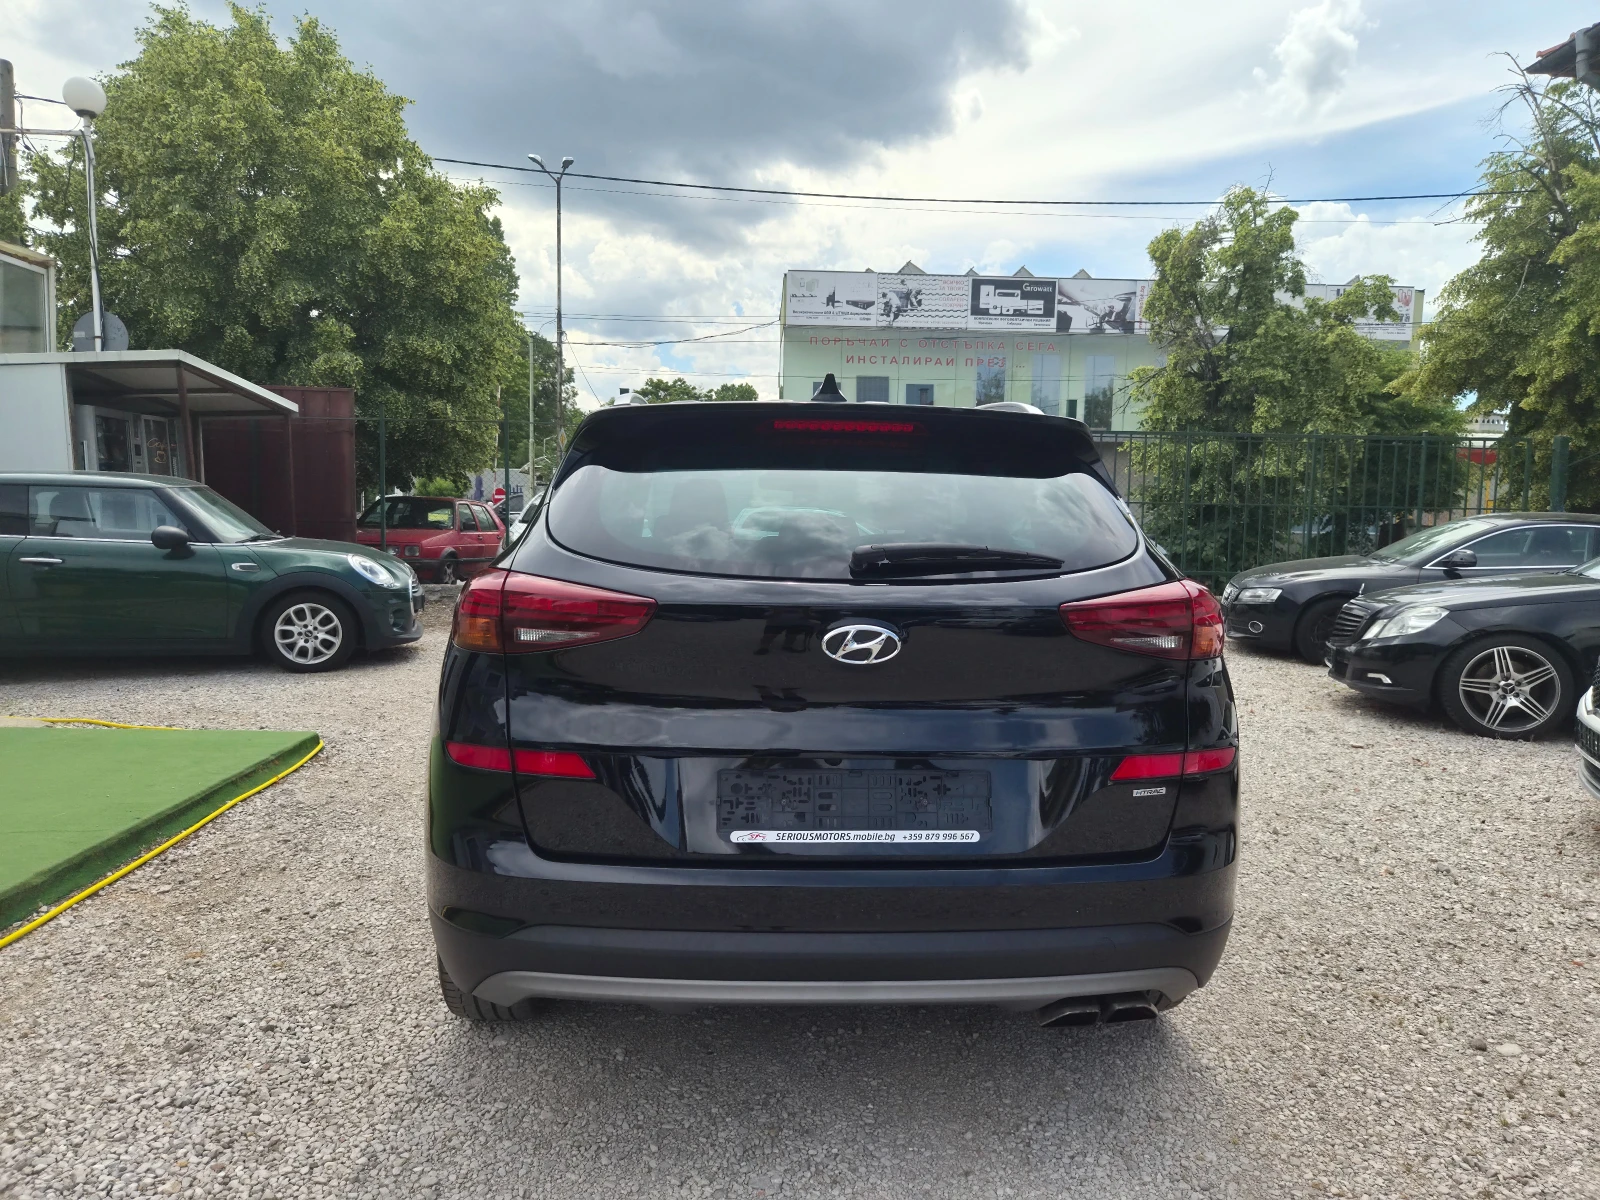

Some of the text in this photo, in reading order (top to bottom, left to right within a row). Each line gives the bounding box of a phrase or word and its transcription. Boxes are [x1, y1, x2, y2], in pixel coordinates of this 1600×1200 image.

[1022, 282, 1053, 293] Growatt
[809, 336, 889, 347] ПОРЪЧАЙ
[900, 338, 908, 348] С
[918, 339, 1005, 350] ОТСТЪПКА
[846, 355, 955, 366] ИНСТАЛИРАЙ
[965, 356, 1006, 368] ПРЕЗ
[775, 832, 896, 842] SERIOUSMOTORS.mobile.bg
[902, 832, 922, 841] +359
[924, 832, 940, 841] 879
[942, 832, 958, 841] 996
[959, 832, 975, 841] 567
